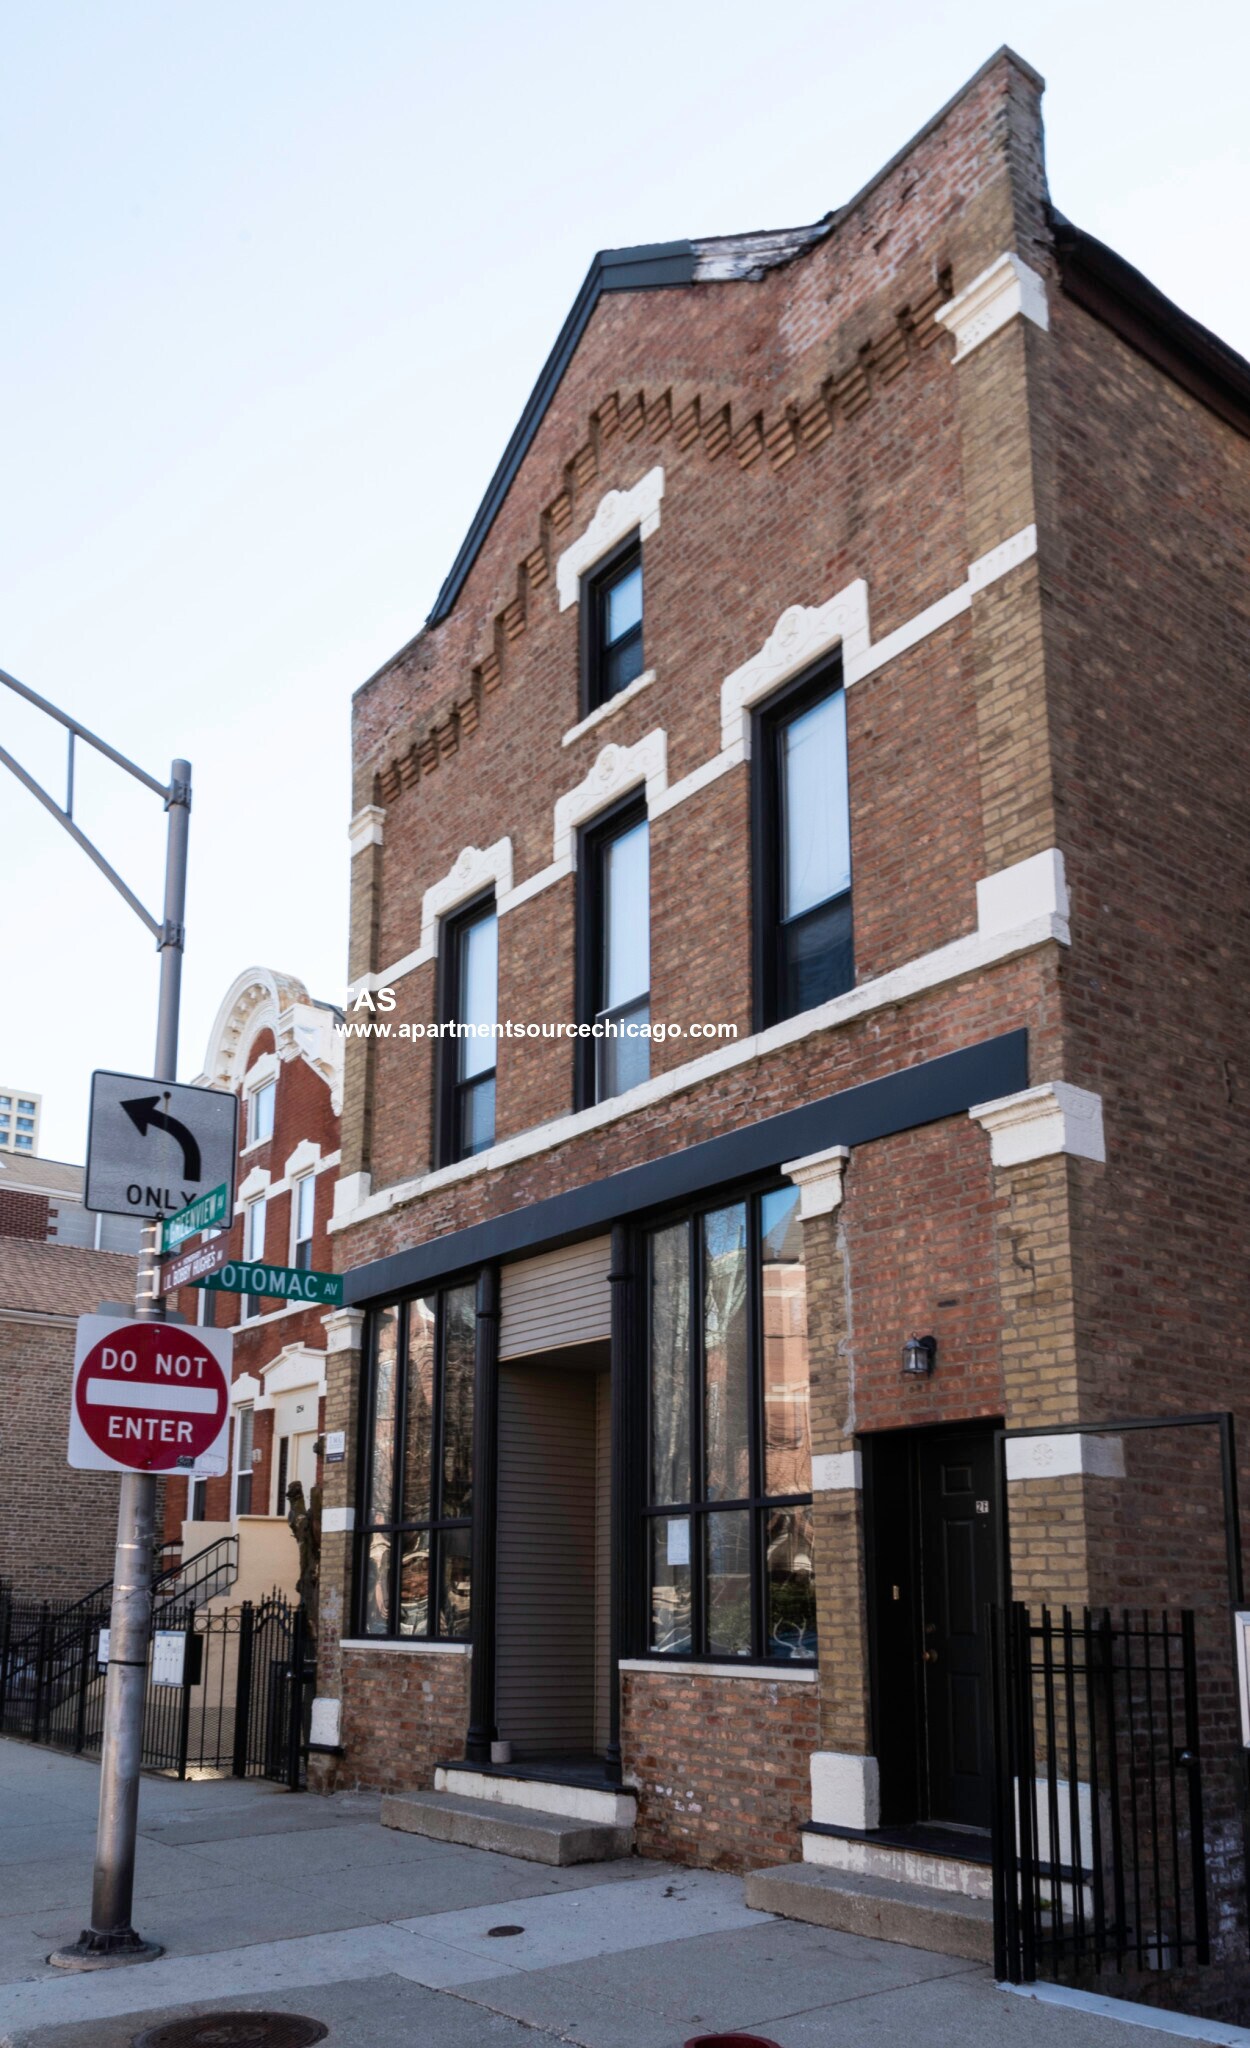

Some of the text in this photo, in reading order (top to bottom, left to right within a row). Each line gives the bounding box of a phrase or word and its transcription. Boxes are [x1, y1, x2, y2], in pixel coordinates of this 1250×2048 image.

[126, 1183, 198, 1210] ONLY
[323, 1282, 338, 1296] AV
[101, 1347, 208, 1379] DO NOT
[108, 1415, 193, 1443] ENTER
